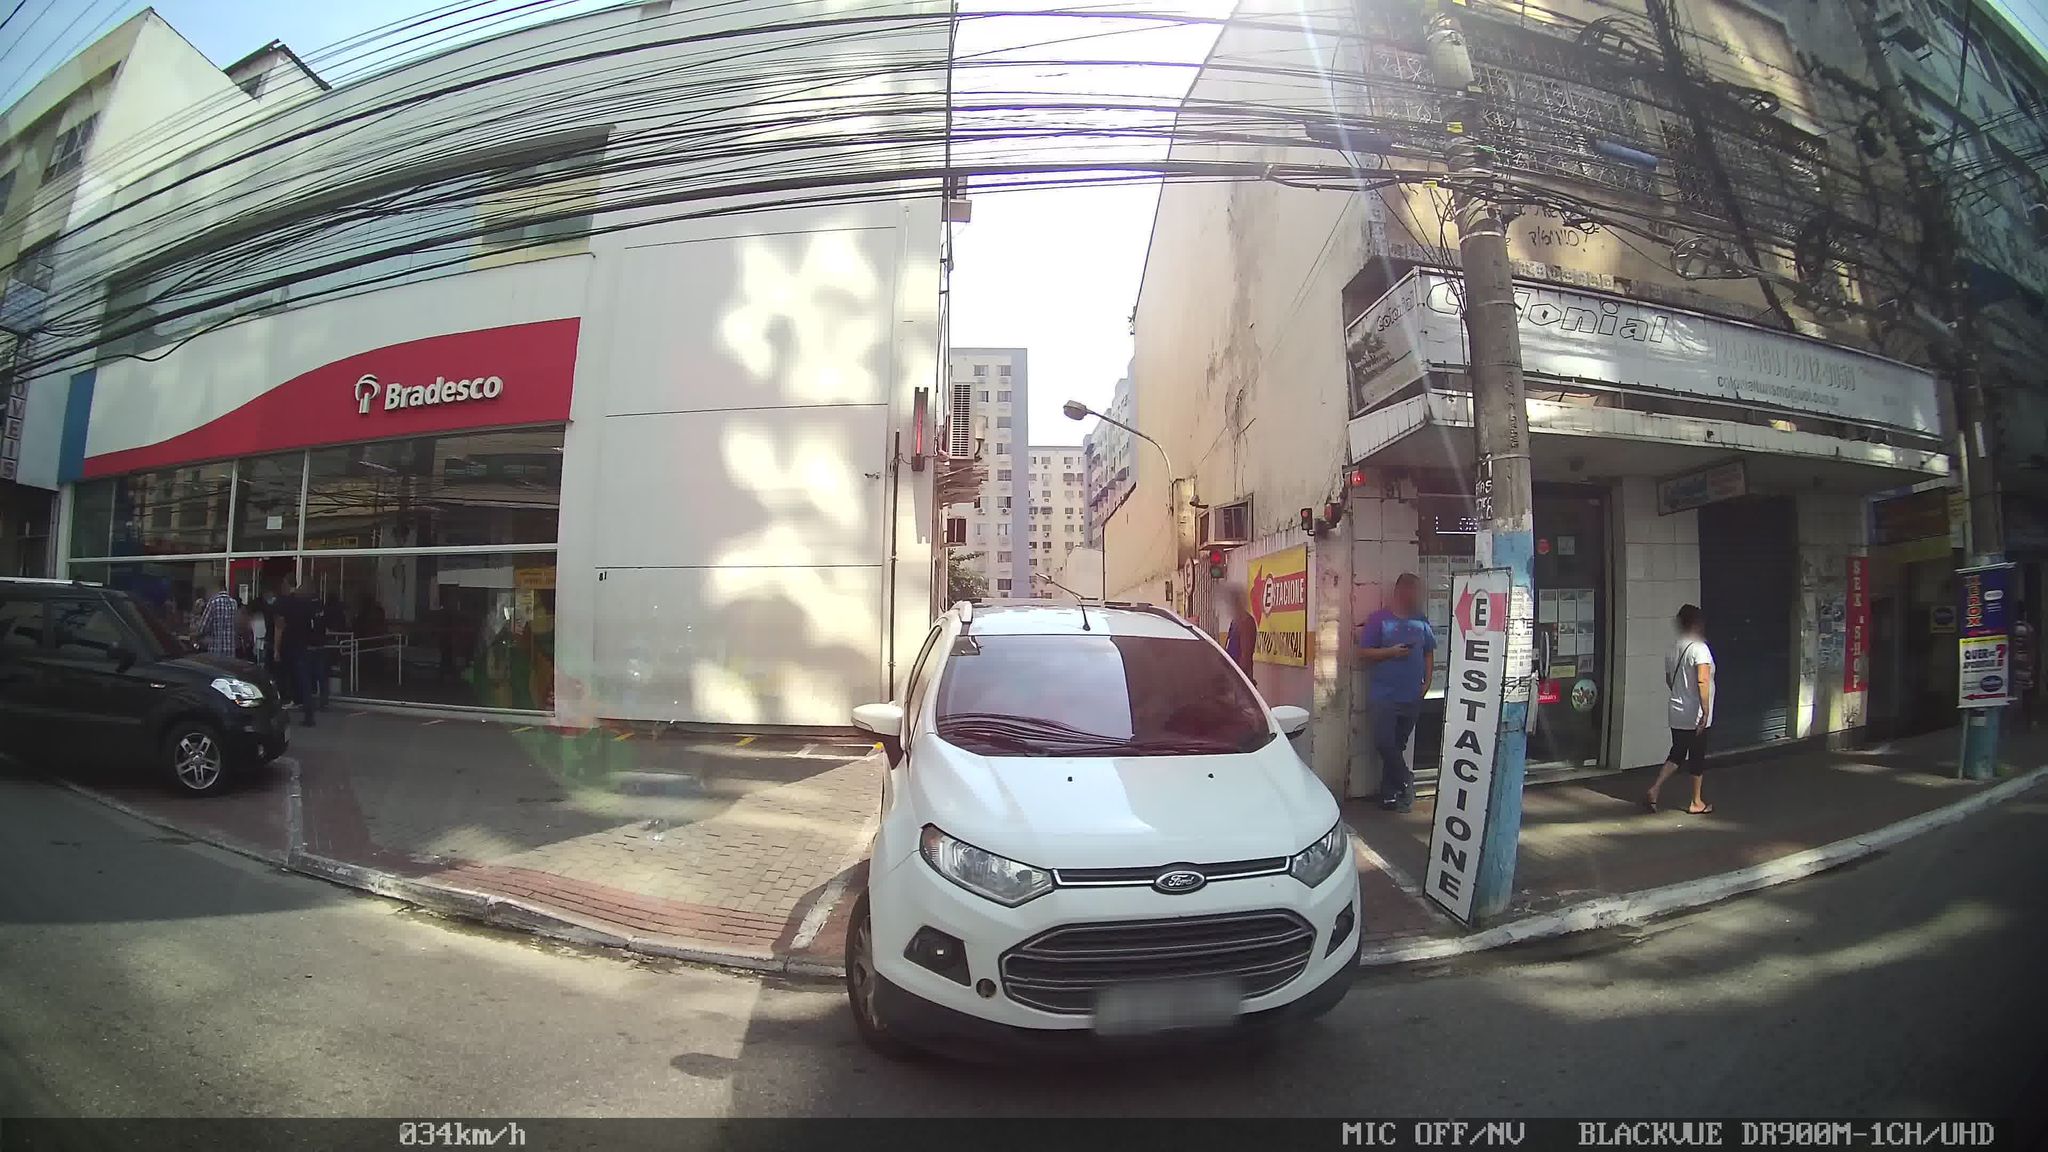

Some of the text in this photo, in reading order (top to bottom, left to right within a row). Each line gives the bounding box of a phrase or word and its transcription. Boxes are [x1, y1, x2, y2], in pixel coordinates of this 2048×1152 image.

[1426, 281, 1669, 344] Clonial
[384, 376, 504, 411] Bradesco
[1438, 639, 1491, 901] ESTACIONE
[1168, 874, 1195, 887] Ford
